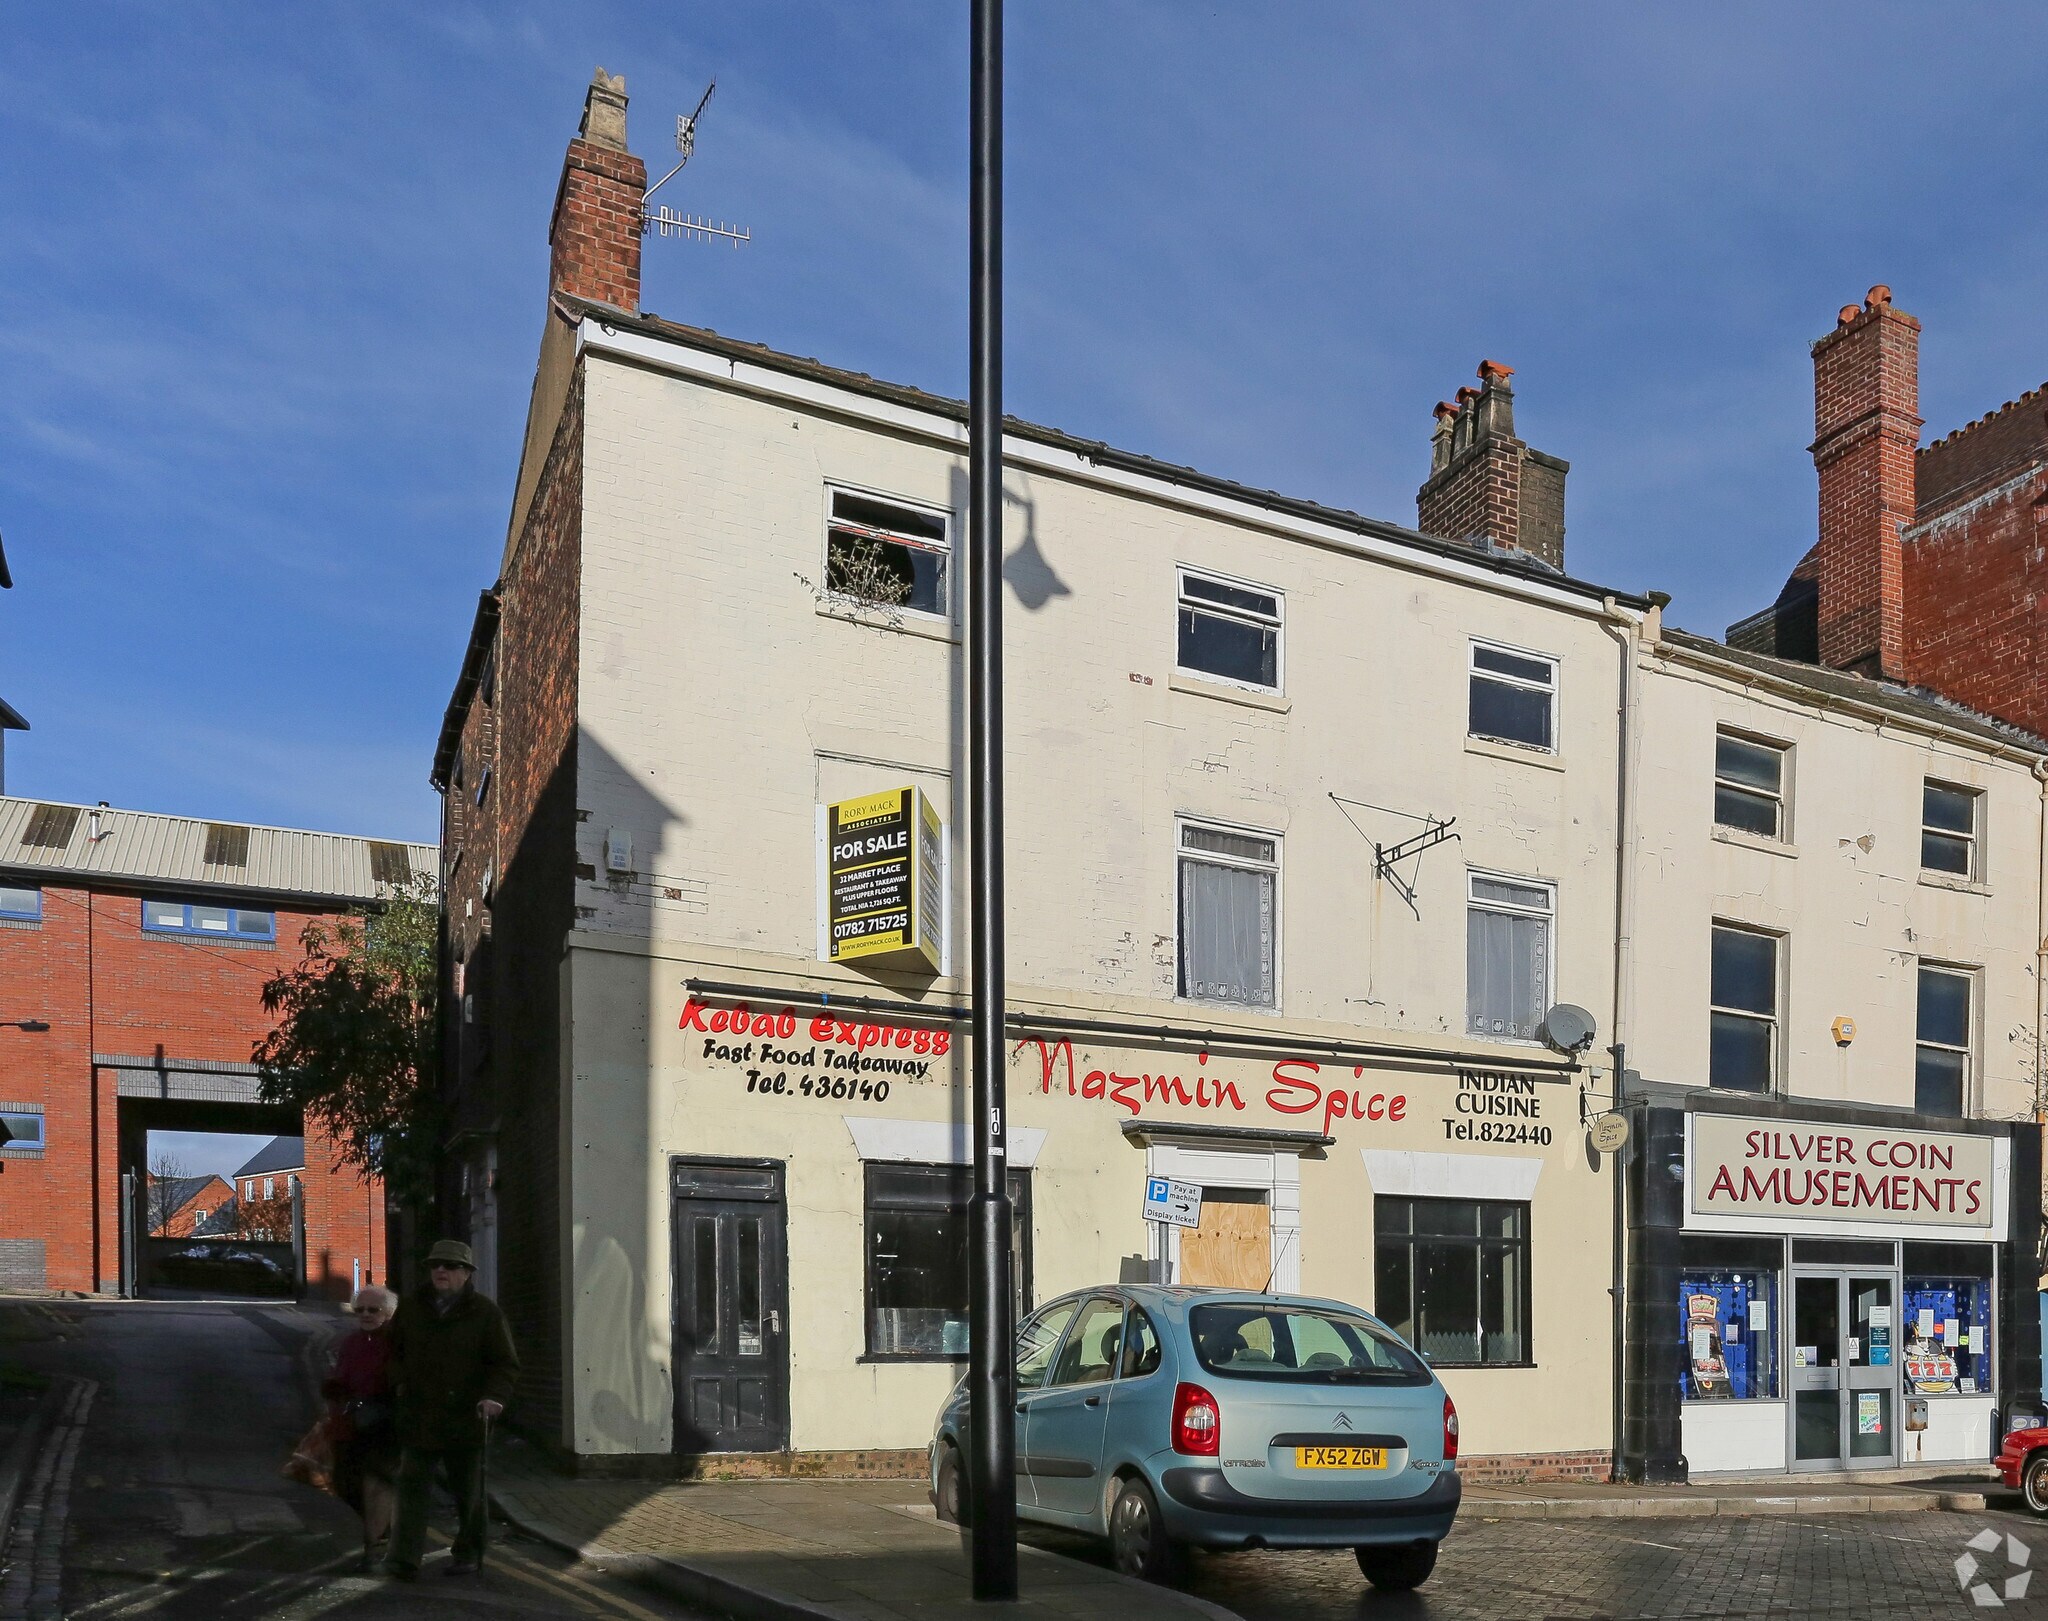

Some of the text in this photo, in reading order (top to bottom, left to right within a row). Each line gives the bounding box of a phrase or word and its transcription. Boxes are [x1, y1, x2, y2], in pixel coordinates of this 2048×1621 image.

[844, 800, 894, 819] RORY MACK
[847, 816, 892, 830] ASSOCIATES
[833, 831, 907, 862] FOR SALE
[840, 864, 901, 884] 32 MARKET PLACE
[834, 883, 870, 895] RESTAURANT
[875, 875, 907, 886] TAKEAWAY
[842, 886, 898, 902] PLUS UPPER FLOORS
[841, 905, 858, 913] TOTAL
[834, 913, 907, 938] 01782 715725
[841, 936, 901, 951] WWW.RORYMACK.CO.UK
[679, 998, 950, 1056] Kebab Express
[703, 1039, 929, 1079] Fast Food Takeaway
[746, 1070, 890, 1102] Tel. 436140
[1012, 1035, 1406, 1137] Nazmin Spice
[1457, 1069, 1535, 1095] INDIAN
[1455, 1093, 1540, 1118] CUISINE
[1442, 1119, 1552, 1146] Tel.822440
[1599, 1132, 1618, 1144] Spice
[1745, 1130, 1953, 1171] SILVER COIN
[1153, 1183, 1166, 1199] P
[1169, 1193, 1199, 1203] machine
[1174, 1185, 1187, 1194] Pay
[1708, 1164, 1982, 1215] AMUSEMENTS
[1147, 1209, 1196, 1224] Display ticket
[1304, 1449, 1380, 1466] FX52 ZGW
